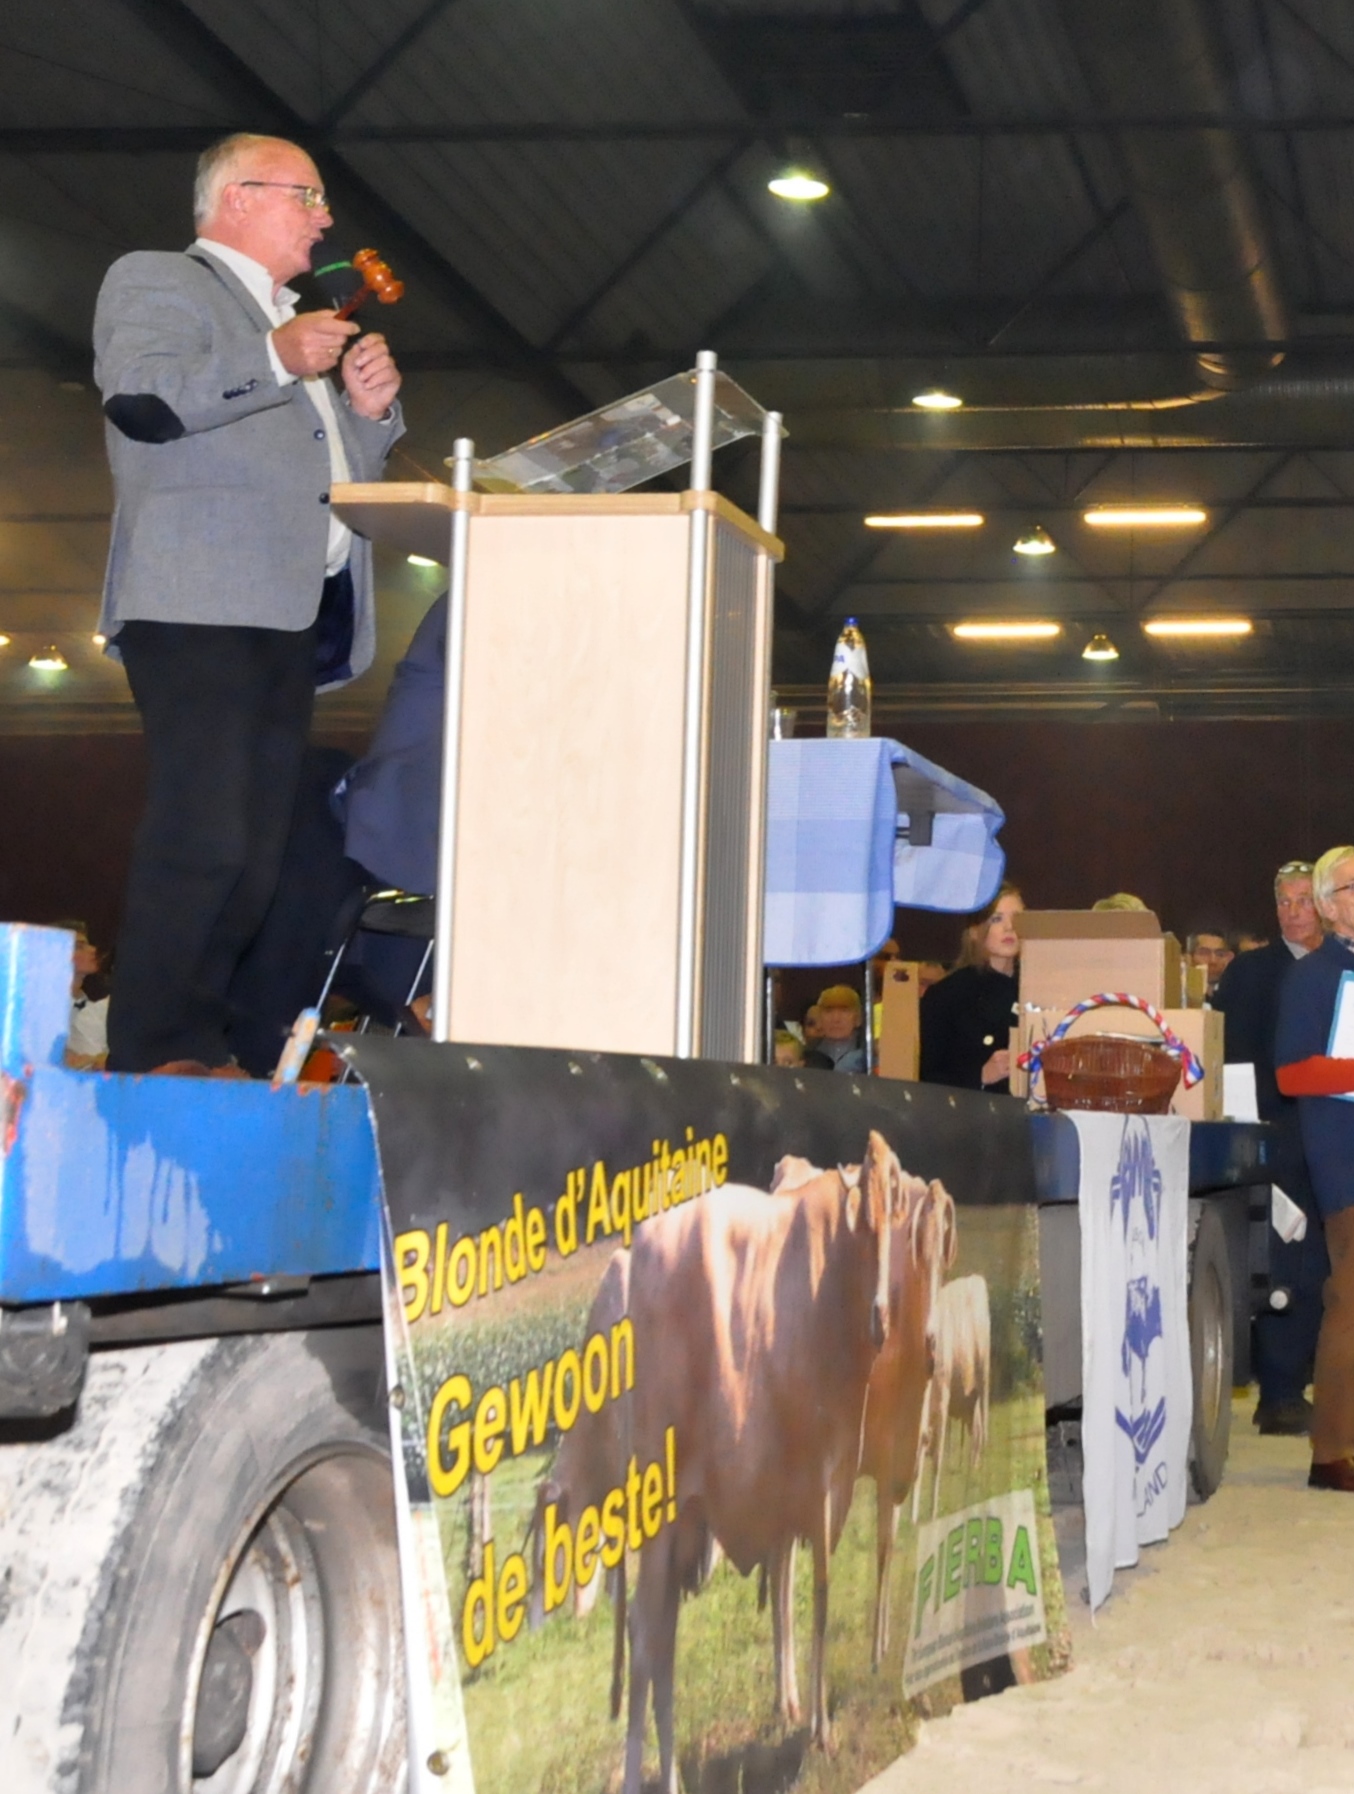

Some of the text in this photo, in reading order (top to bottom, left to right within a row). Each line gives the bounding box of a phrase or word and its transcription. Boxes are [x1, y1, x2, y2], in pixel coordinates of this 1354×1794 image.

[394, 1126, 730, 1325] Blonde d'Aquitaine
[427, 1317, 636, 1499] Gewoon
[461, 1425, 678, 1668] de beste!
[914, 1516, 1038, 1640] FIERBA
